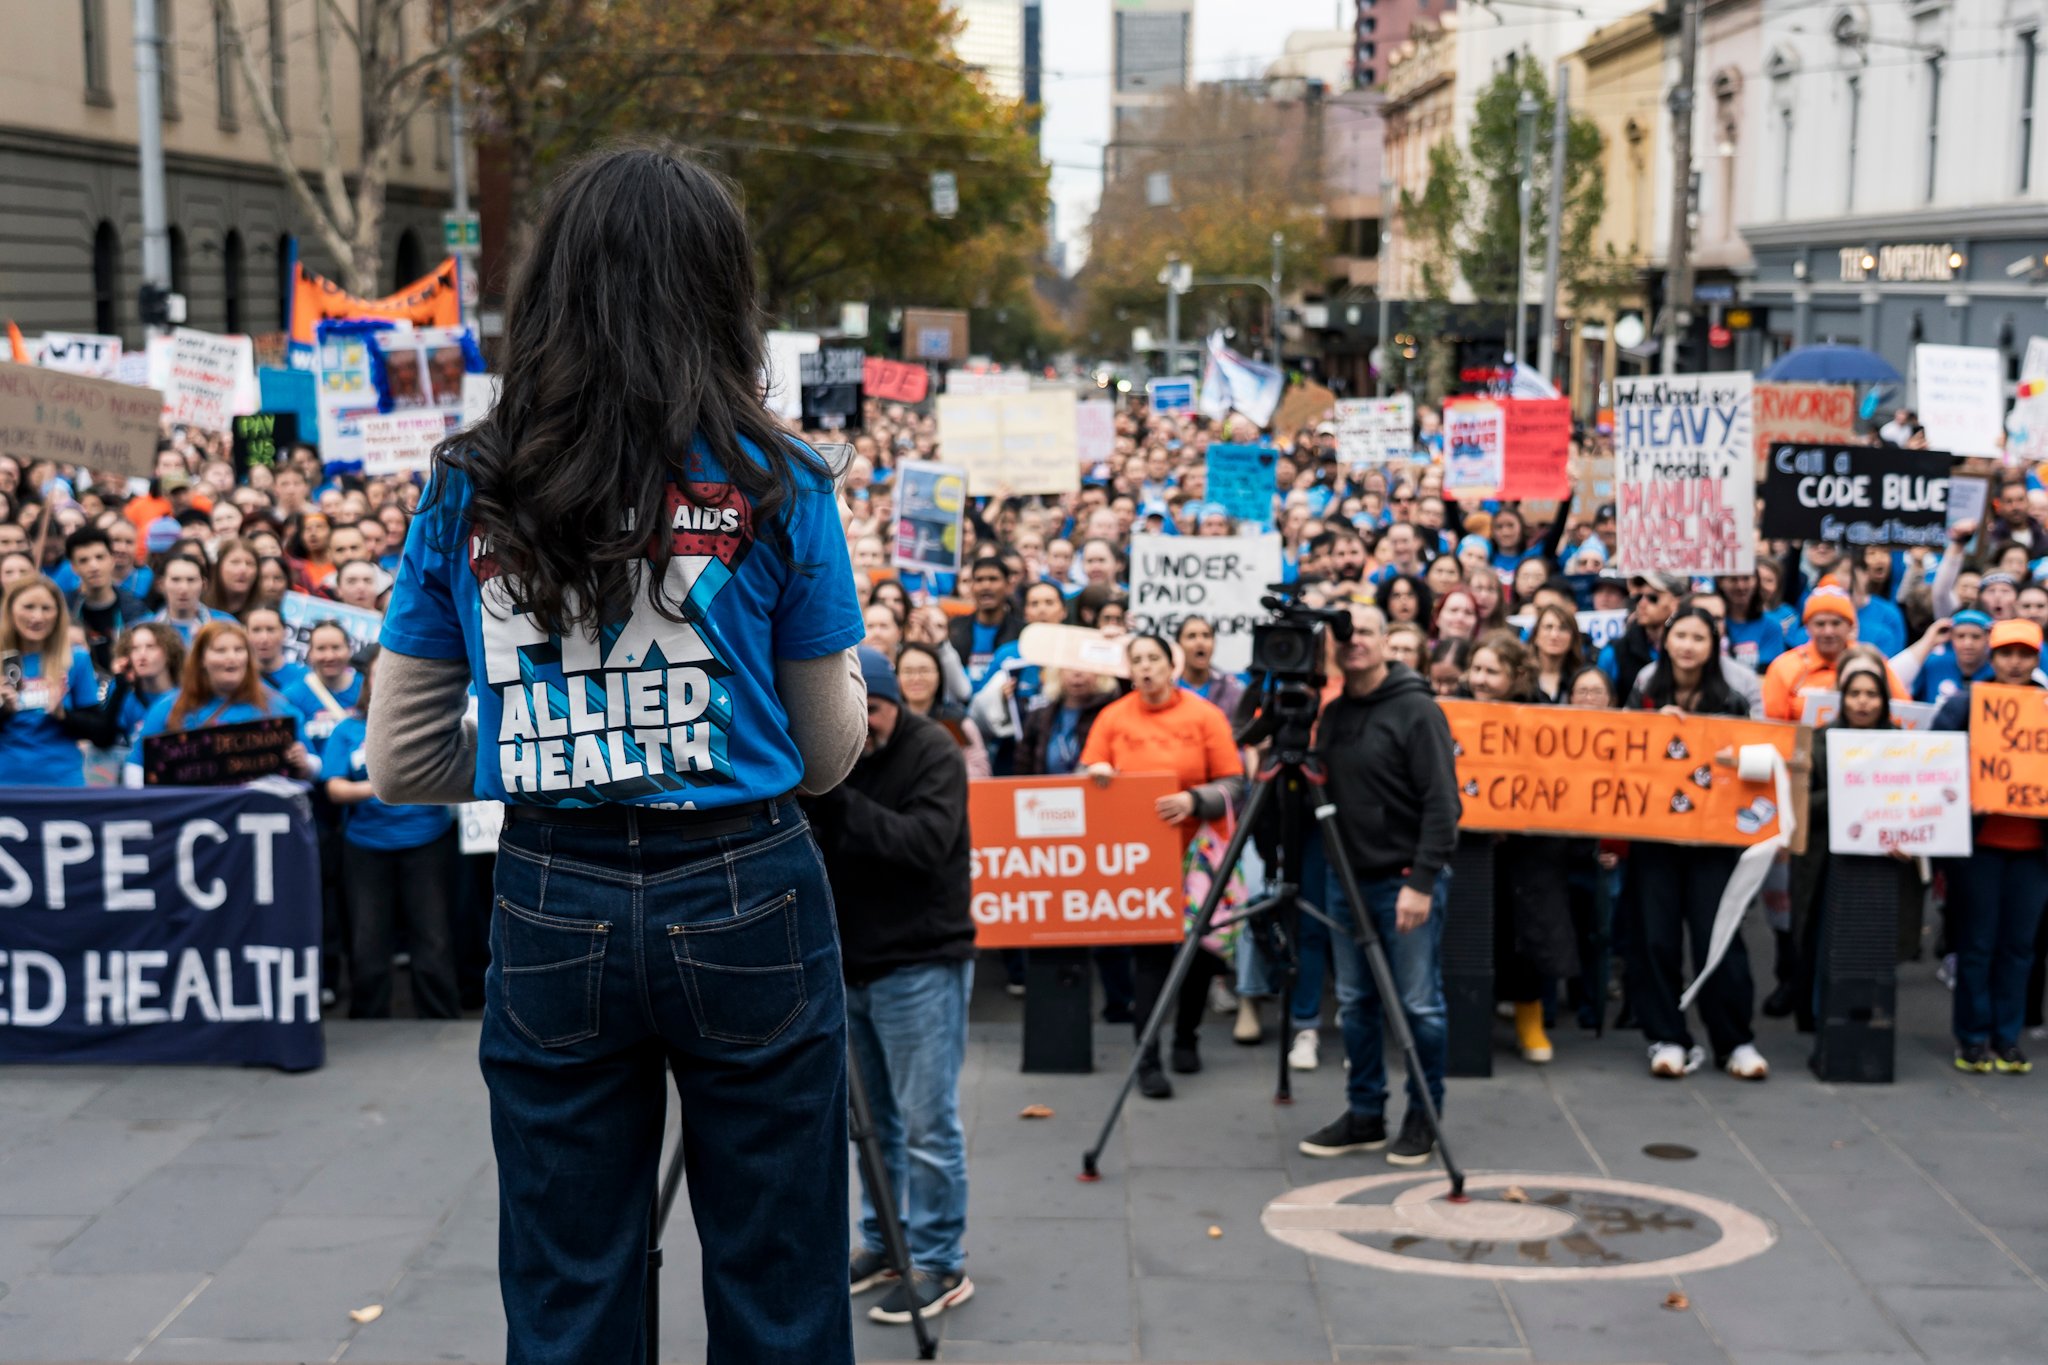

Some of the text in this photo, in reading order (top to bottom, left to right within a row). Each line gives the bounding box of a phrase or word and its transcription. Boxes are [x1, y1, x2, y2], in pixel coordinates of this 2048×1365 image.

[1625, 404, 1738, 447] HEAVY
[1620, 477, 1734, 517] MANUAL
[1797, 475, 1871, 508] CODE
[1882, 473, 1949, 512] BLUE
[672, 504, 740, 533] AIDS
[1143, 553, 1256, 581] UNDER-
[498, 667, 711, 742] ALLIED
[1983, 697, 2019, 723] NO
[500, 721, 713, 794] HEALTH
[1480, 720, 1649, 762] ENOUGH
[1980, 756, 2012, 781] NO
[1488, 774, 1651, 817] CRAP PAY
[1095, 842, 1151, 876] UP
[1062, 886, 1175, 922] BACK
[84, 945, 322, 1026] HEALTH
